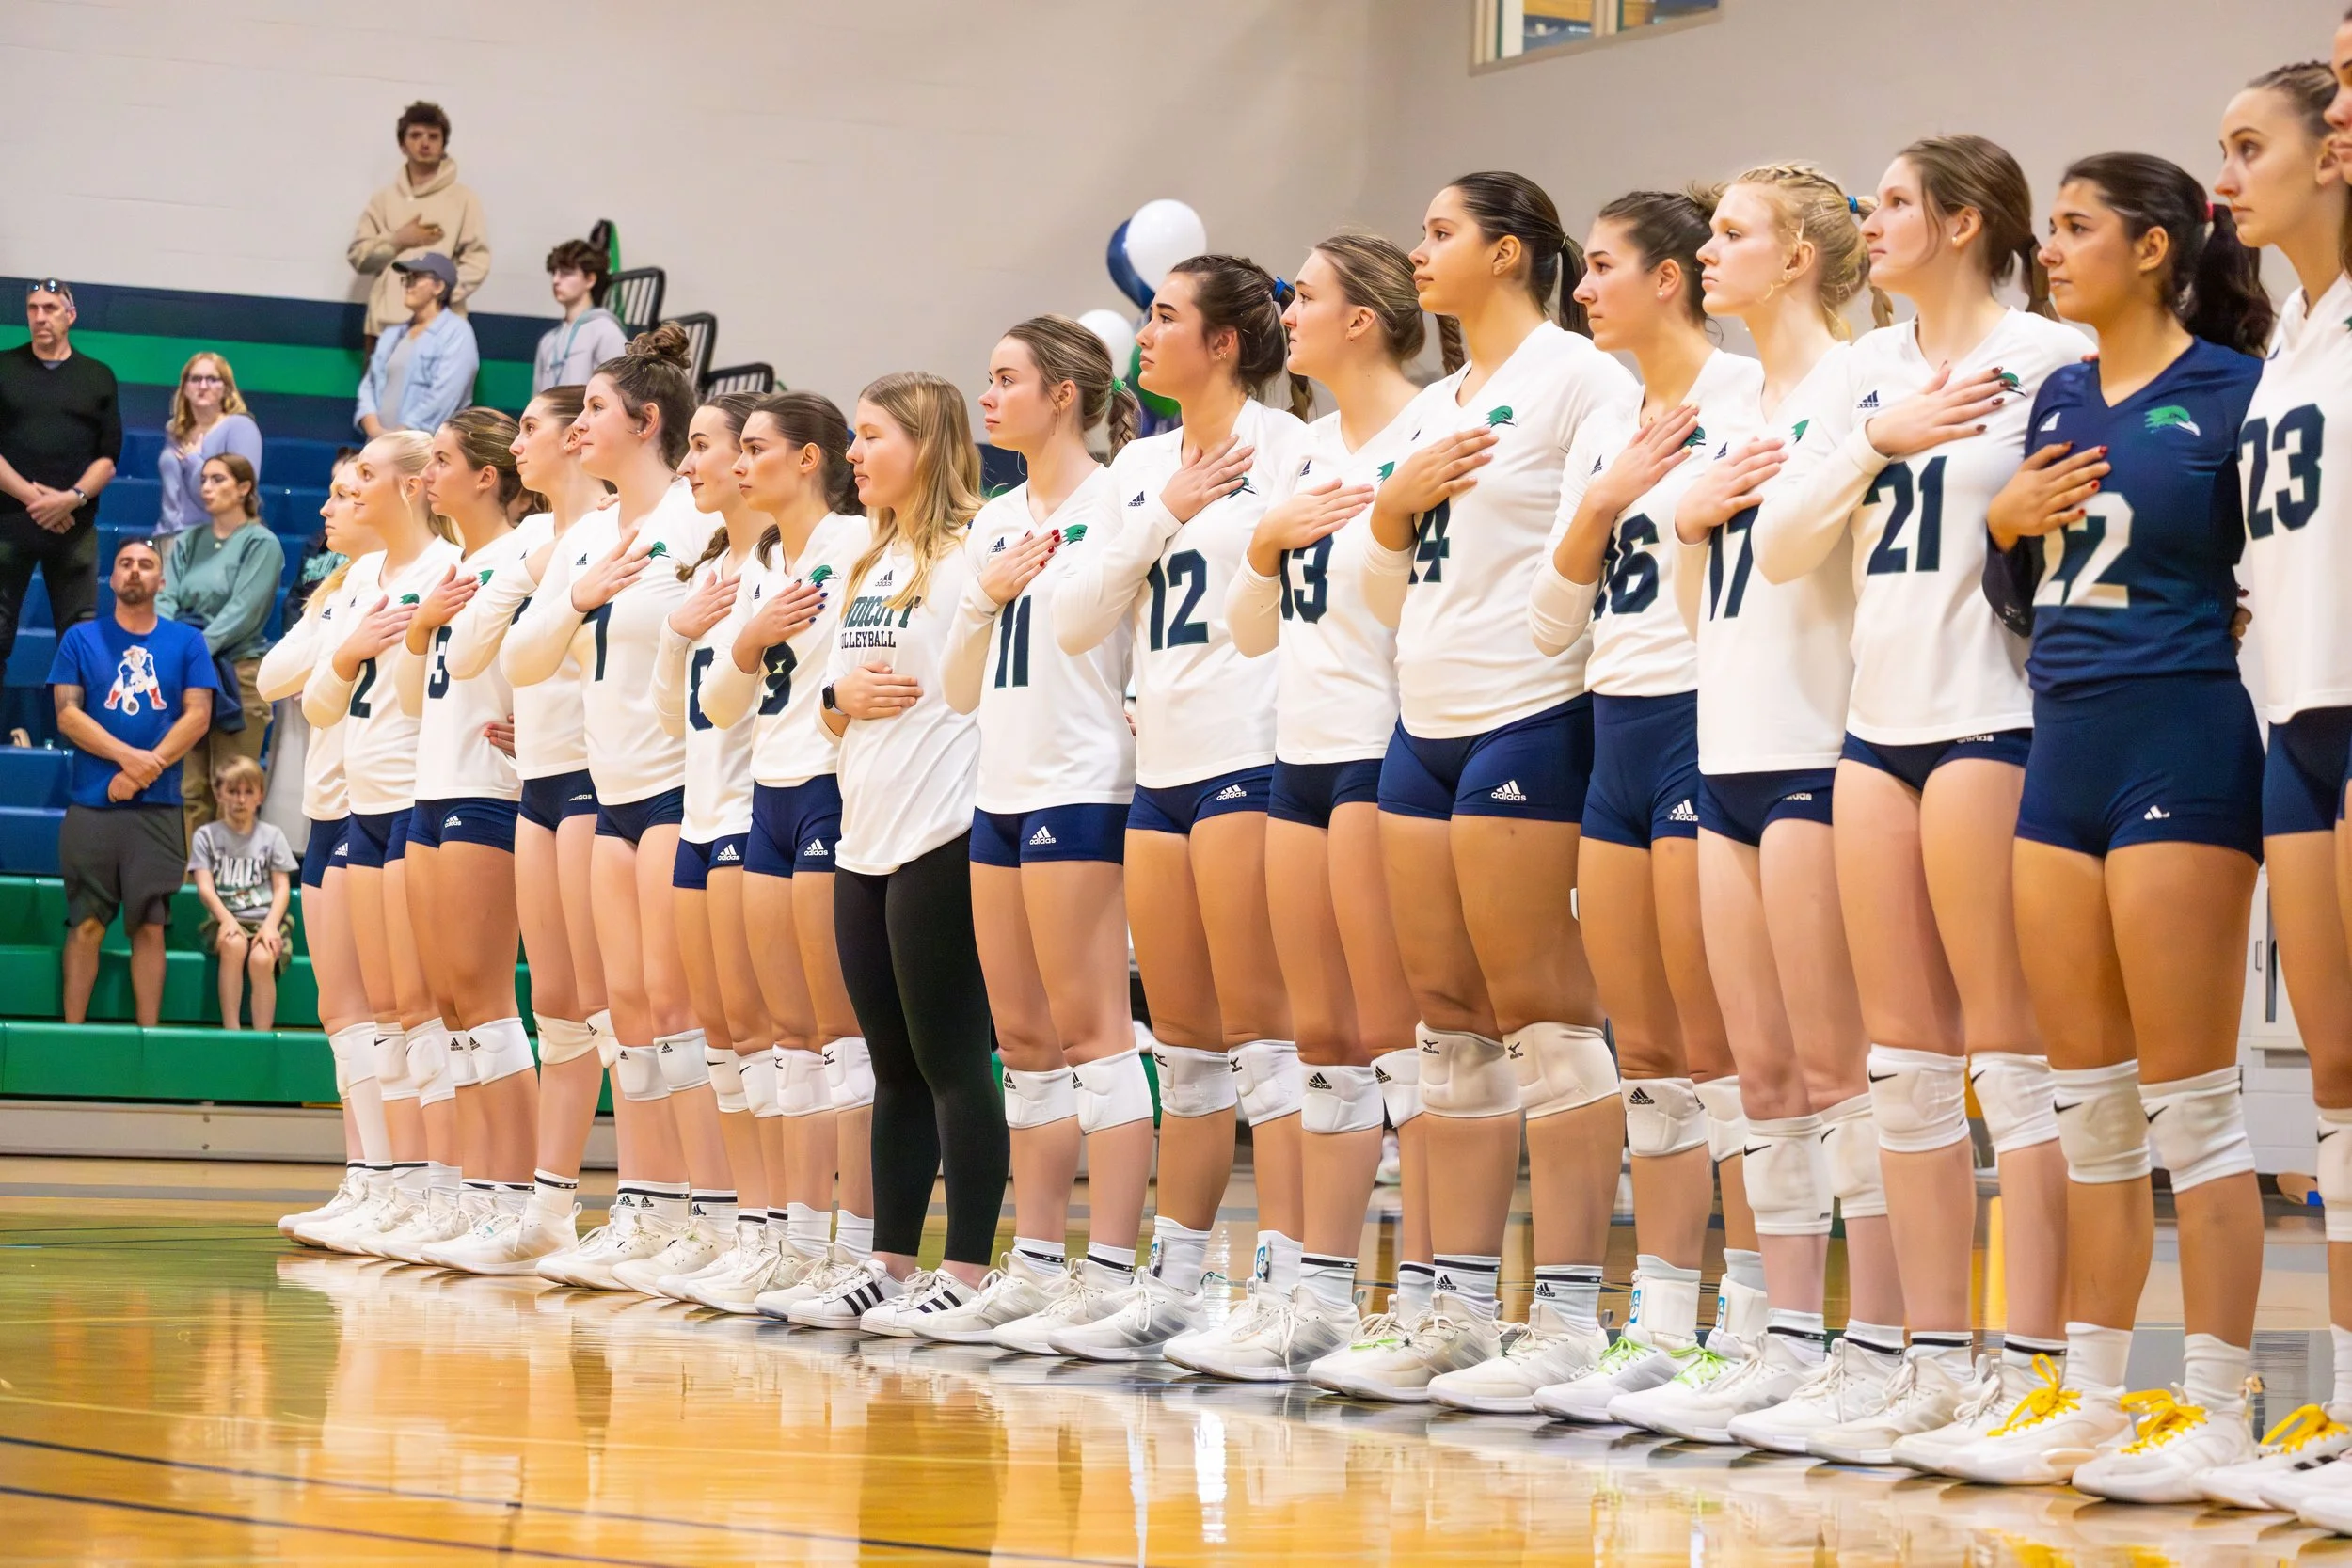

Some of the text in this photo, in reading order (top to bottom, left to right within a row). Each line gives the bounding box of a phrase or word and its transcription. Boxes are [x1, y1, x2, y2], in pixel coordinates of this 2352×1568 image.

[2237, 403, 2325, 540] 23
[1863, 455, 1947, 576] 21
[1146, 548, 1209, 652] 12
[1280, 533, 1334, 625] 13
[1708, 504, 1760, 621] 17
[428, 626, 452, 699] 3
[581, 601, 613, 681] 7
[994, 595, 1031, 689] 11
[349, 657, 376, 718] 2
[1216, 790, 1247, 800] adidas
[1491, 791, 1526, 801] adidas
[1029, 836, 1056, 845] adidas
[1309, 1081, 1332, 1090] adidas
